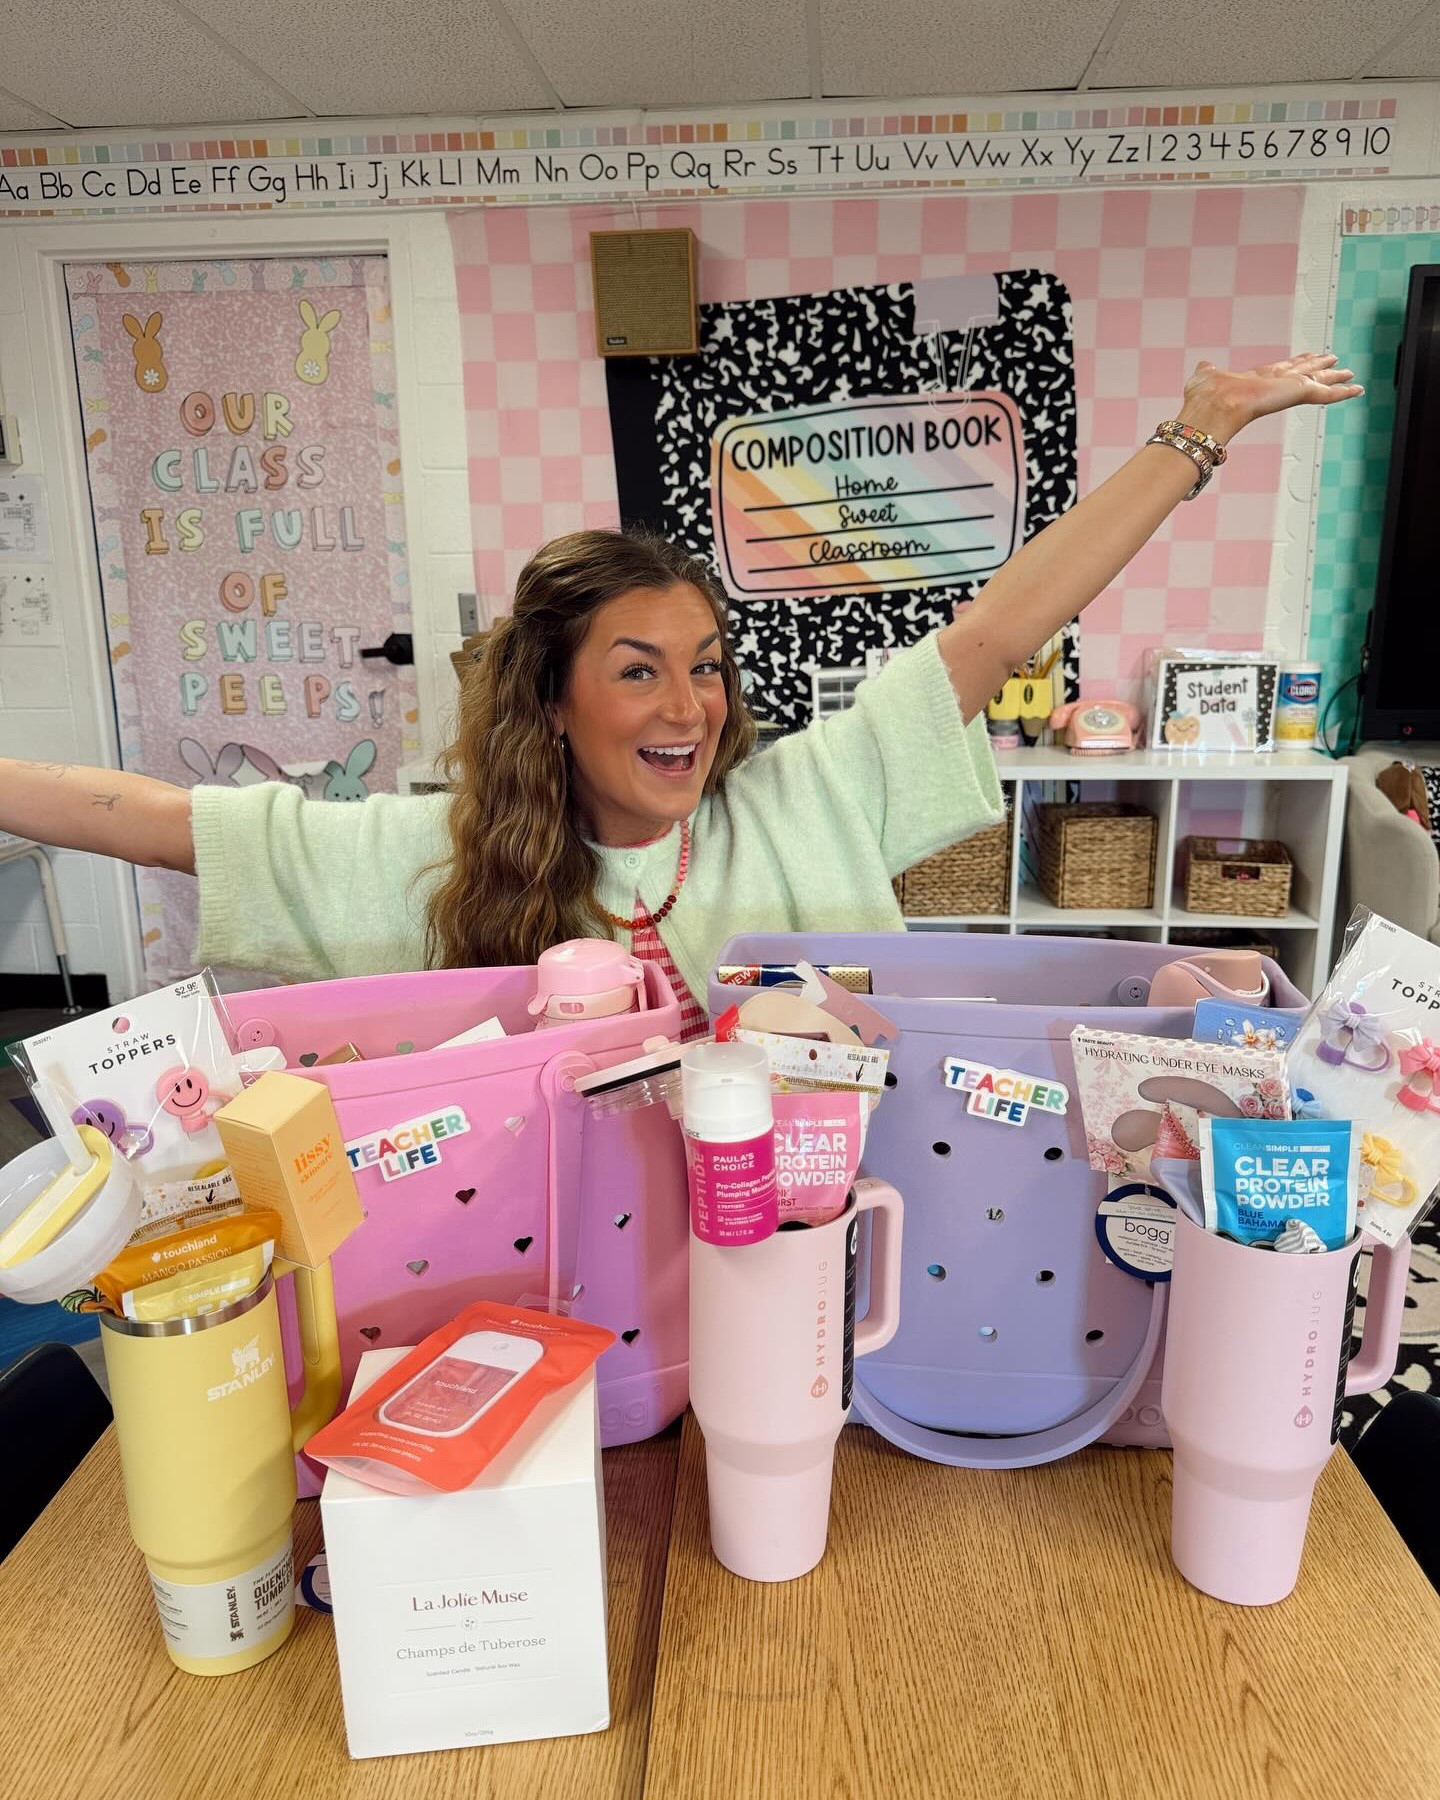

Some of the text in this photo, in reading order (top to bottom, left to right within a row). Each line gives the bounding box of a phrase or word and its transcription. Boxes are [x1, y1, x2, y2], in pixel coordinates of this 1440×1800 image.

[40, 172, 73, 199] Bb
[81, 170, 117, 197] Cc
[127, 168, 161, 196] Dd
[172, 167, 201, 194] Ee
[212, 166, 239, 193] Ff
[248, 164, 287, 203] Gg
[296, 163, 328, 191] Hh
[337, 162, 354, 190] Ii
[367, 161, 389, 200] Jj
[402, 159, 431, 187] Kk
[440, 158, 462, 186] Ll
[477, 157, 520, 185] Mm
[535, 155, 568, 183] Nn
[579, 154, 618, 181] Oo
[627, 152, 660, 192] Pp
[670, 151, 720, 189] Qq
[724, 149, 756, 177] Rr
[767, 148, 797, 176] Ss
[808, 146, 845, 173] Tt
[856, 145, 890, 172] Uu
[903, 141, 939, 170] Vv
[946, 140, 1011, 168] Ww
[1020, 138, 1053, 167] Xx
[1064, 136, 1096, 177] Yy
[1106, 134, 1139, 164] Zz
[1161, 133, 1180, 162] 2
[1186, 133, 1202, 161] 3
[1210, 132, 1230, 160] 4
[1238, 131, 1255, 159] 5
[1263, 130, 1279, 158] 6
[1287, 129, 1305, 158] 7
[1310, 128, 1328, 156] 8
[1336, 127, 1351, 156] 9
[1363, 126, 1390, 155] 10
[179, 391, 295, 441] OUR
[731, 414, 1002, 472] COMPOSITION BOOK
[152, 445, 326, 494] CLASS
[834, 475, 899, 499] Home
[837, 502, 900, 529] Sweet
[140, 506, 365, 555] IS FULL
[809, 537, 930, 564] Classroom
[218, 571, 288, 617] OF
[179, 619, 361, 669] SWEET
[1187, 678, 1249, 699] Student
[1200, 698, 1236, 715] Data
[728, 969, 751, 985] NEW
[88, 1034, 177, 1075] TOPPERS
[106, 1032, 150, 1054] STRAW
[1085, 1047, 1266, 1079] HYDRATING UNDER EYE MASKS
[950, 1065, 1064, 1110] TEACHER
[973, 1094, 1025, 1122] LIFE
[294, 1134, 332, 1173] lissy
[346, 1113, 465, 1168] TEACHER
[384, 1143, 438, 1178] LIFE
[713, 1152, 755, 1163] PAULA'S
[714, 1161, 755, 1171] CHOICE
[1234, 1156, 1330, 1177] CLEAR
[716, 1179, 761, 1190] Pro-Collagen
[776, 1170, 847, 1186] OWDER
[1235, 1176, 1328, 1193] PROTEIN
[695, 1153, 710, 1233] PEPTIDE
[716, 1190, 750, 1198] Plumping
[777, 1198, 796, 1207] RST
[1236, 1193, 1330, 1209] POWDER
[1238, 1209, 1264, 1219] BLUE
[1125, 1217, 1169, 1244] bogg
[162, 1235, 217, 1260] touchland
[142, 1246, 232, 1284] MANGO PASSION
[207, 1352, 275, 1402] STANLEY
[254, 1562, 293, 1599] QUENCH
[226, 1586, 241, 1629] STANLEY
[412, 1589, 528, 1612] La Jolie Muse
[396, 1636, 547, 1660] Champs de Tuberose
